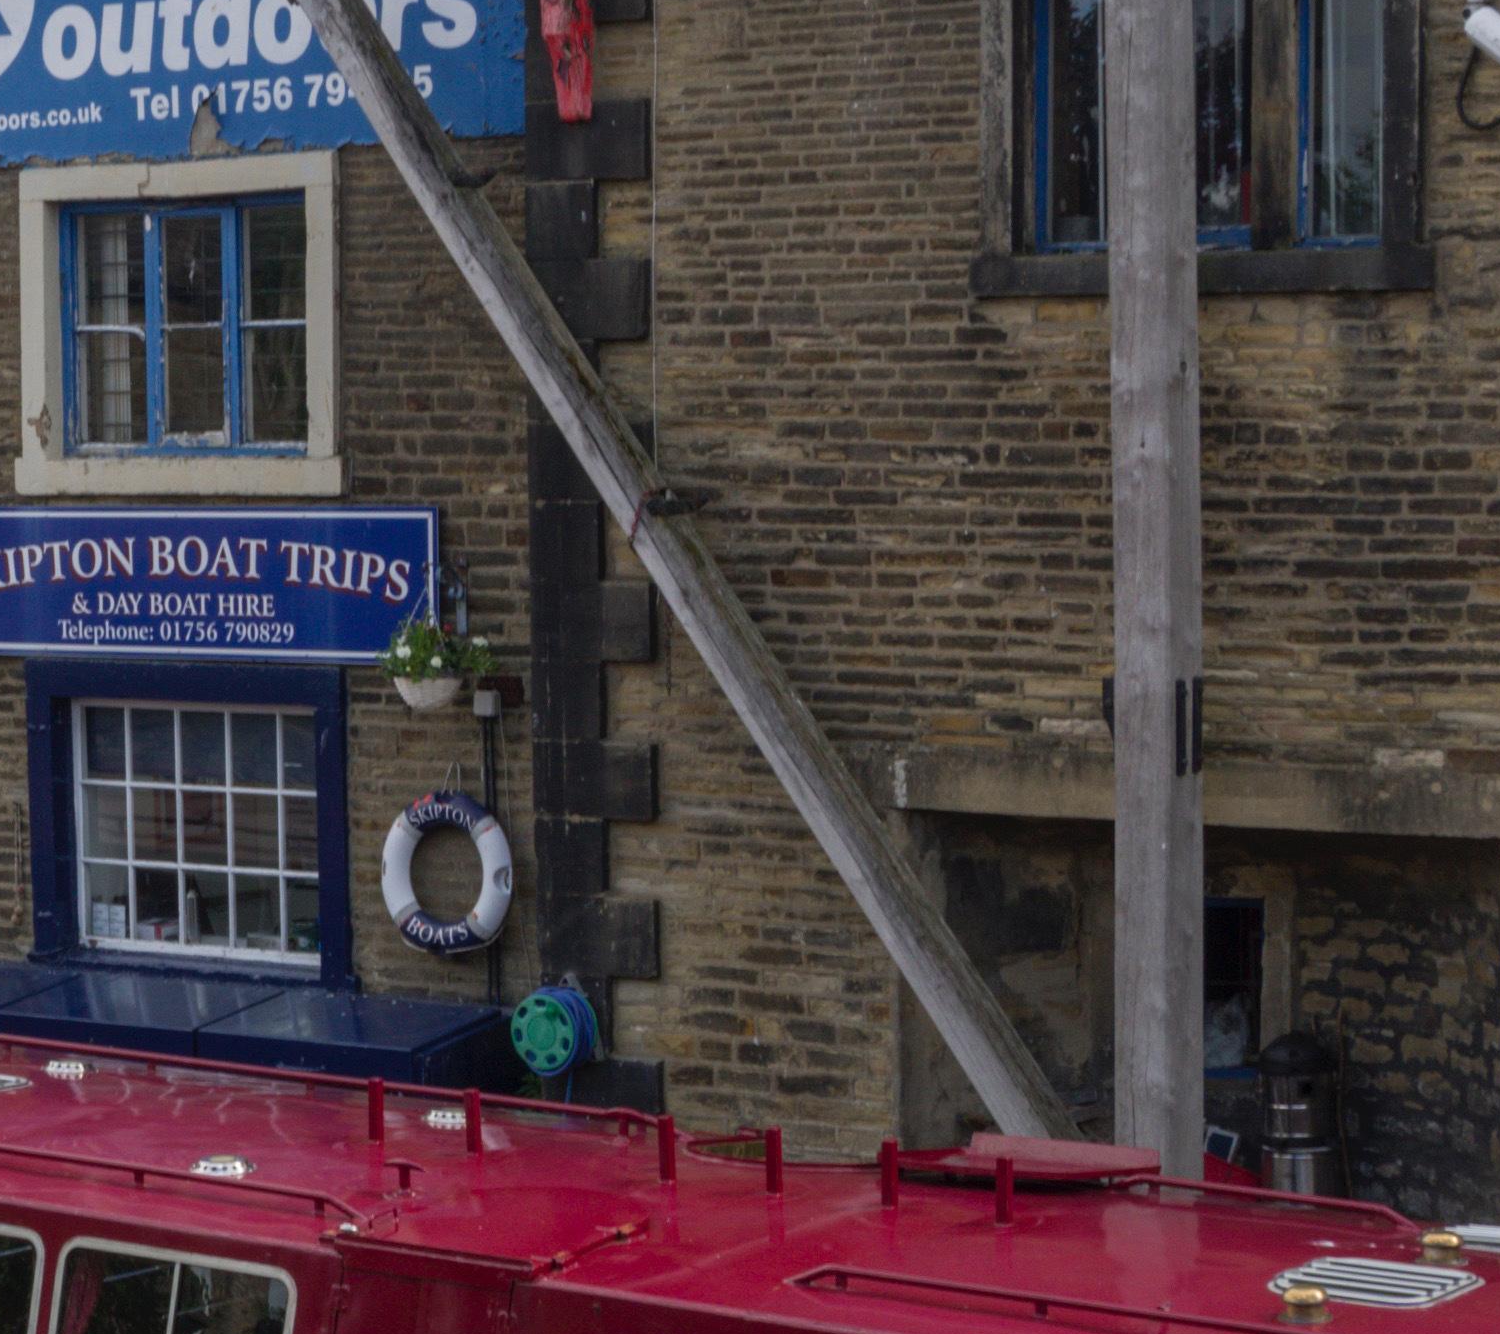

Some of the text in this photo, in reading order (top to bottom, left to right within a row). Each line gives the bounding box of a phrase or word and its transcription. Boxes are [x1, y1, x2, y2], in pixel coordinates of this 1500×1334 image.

[130, 65, 433, 121] Tel 01756 795
[148, 536, 267, 578] BOAT
[279, 539, 411, 602] TRIPS
[71, 592, 276, 617] & DAY BOAT HIRE
[57, 618, 295, 645] Telephone: 01756 790829
[409, 804, 476, 832] SKIPTON
[405, 915, 469, 945] BOATS
